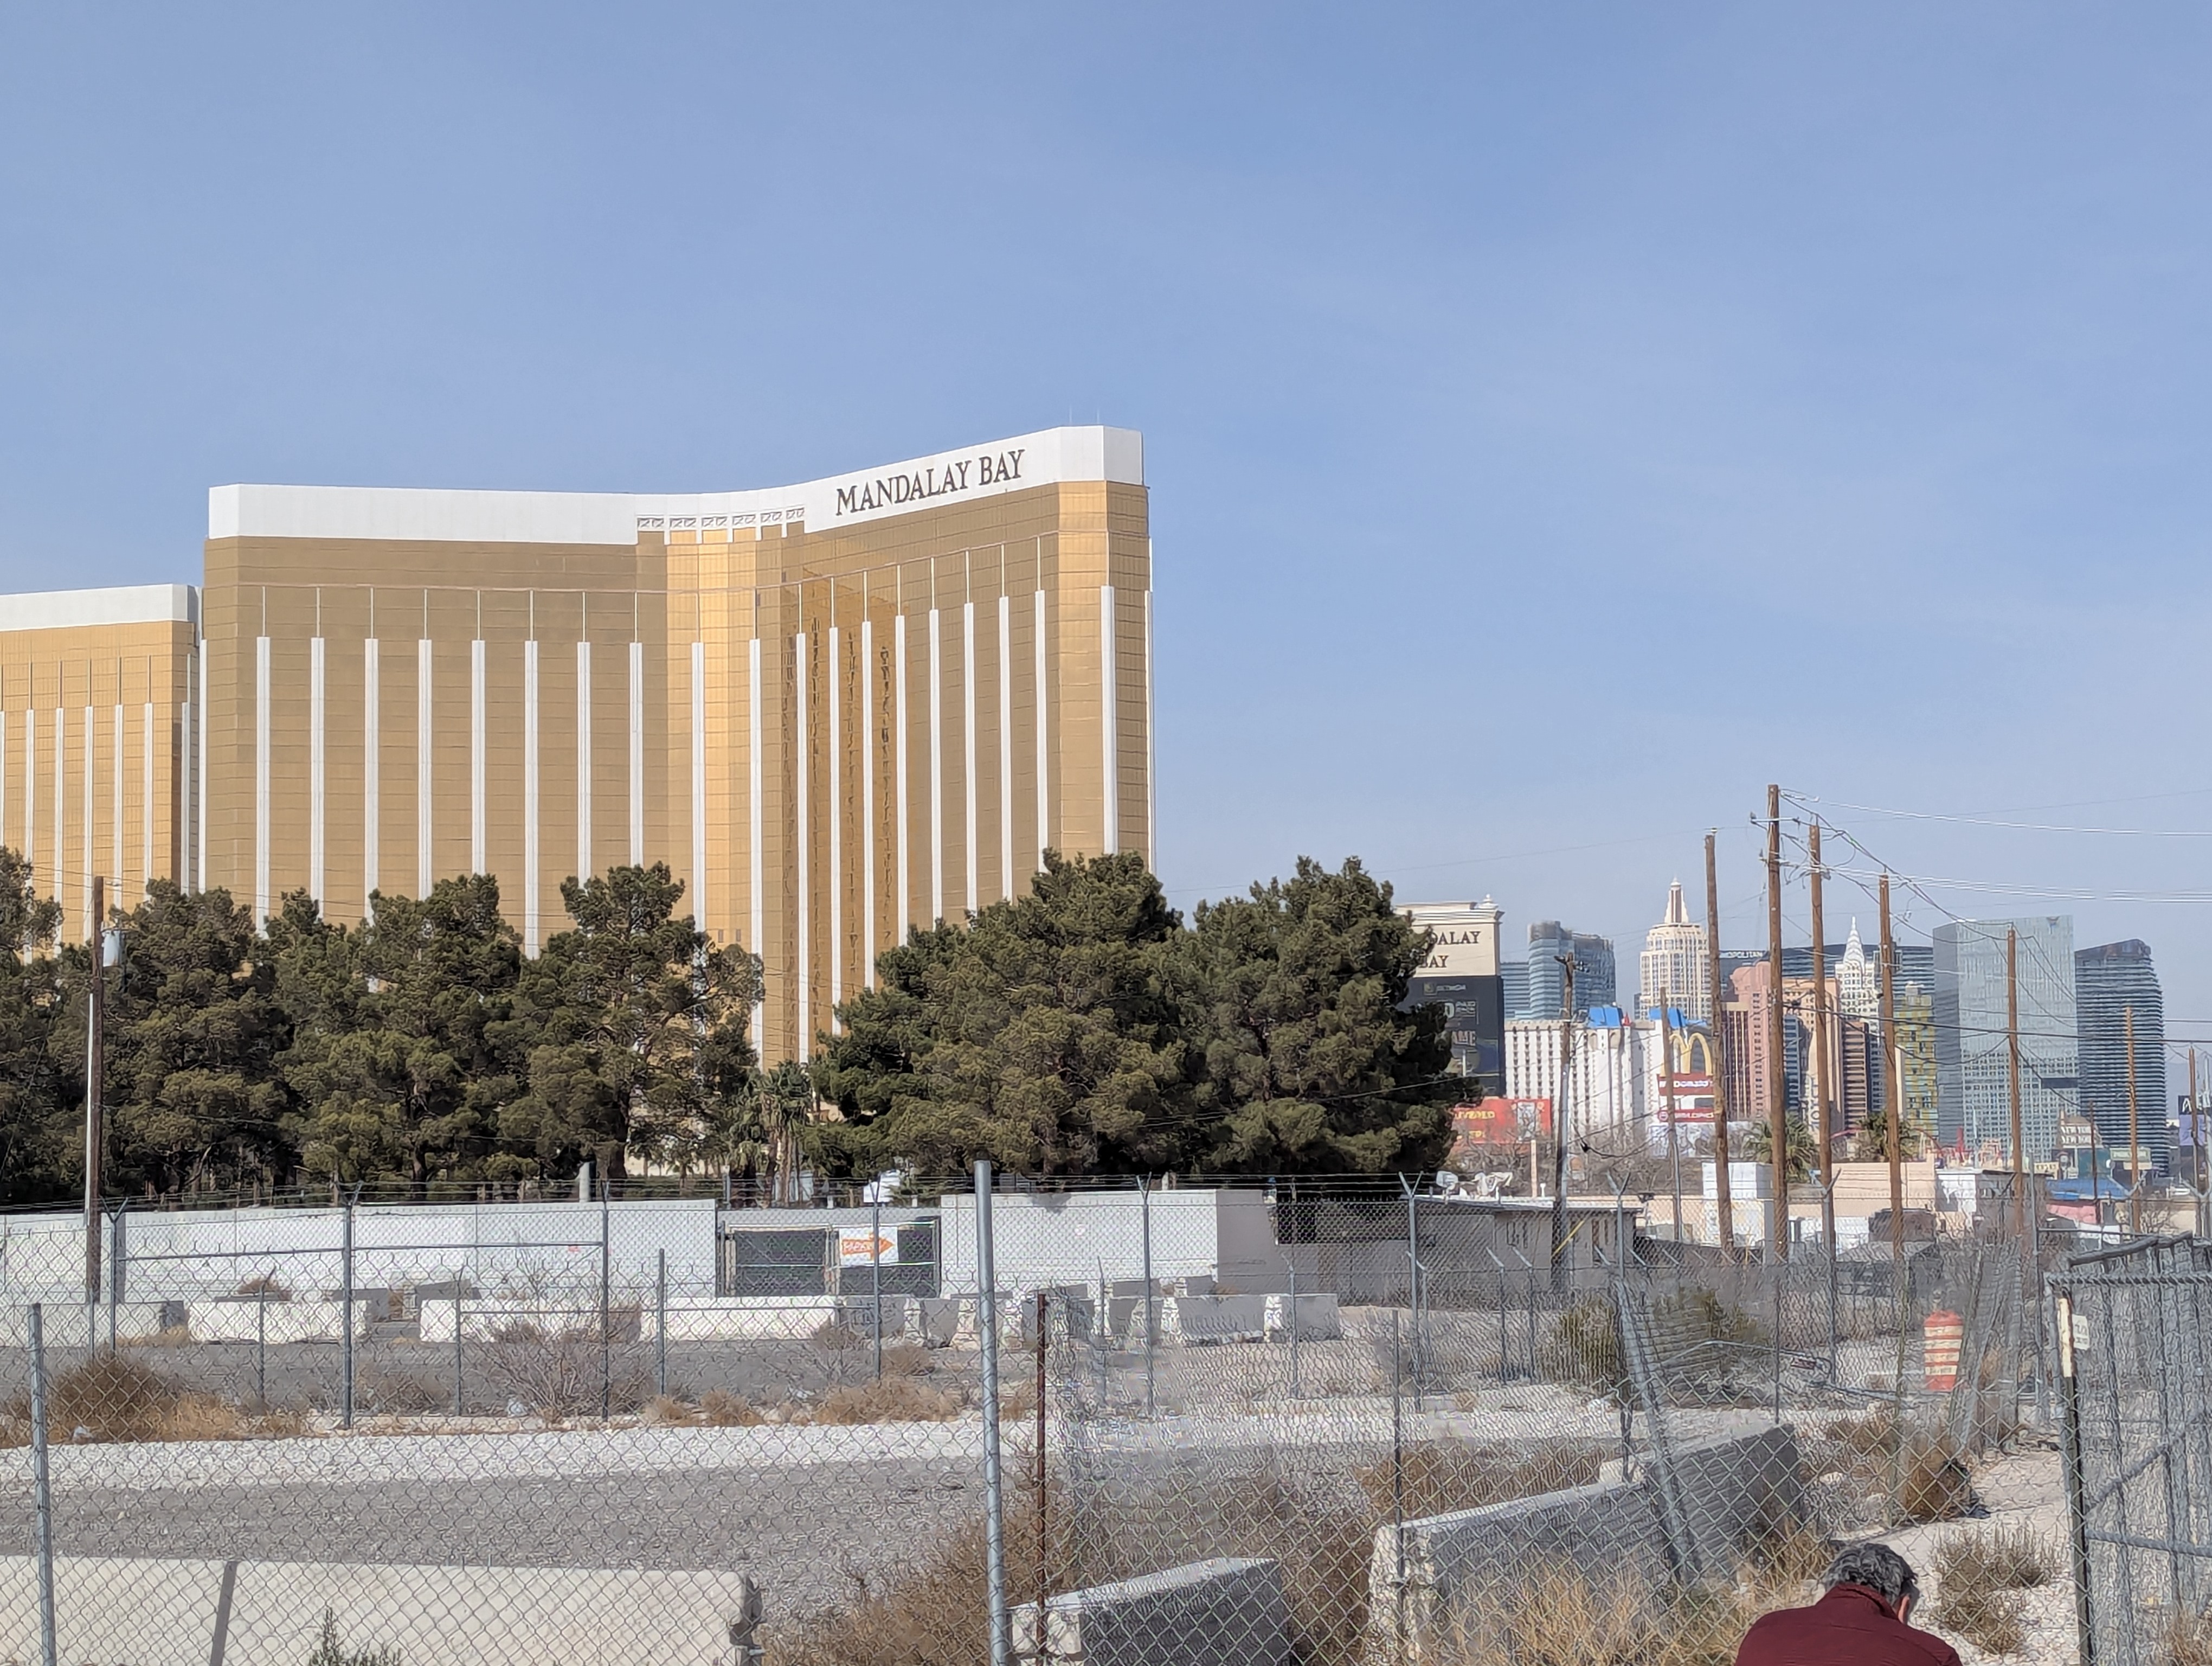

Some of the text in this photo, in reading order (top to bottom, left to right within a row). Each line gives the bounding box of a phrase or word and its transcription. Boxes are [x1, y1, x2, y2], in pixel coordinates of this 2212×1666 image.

[835, 449, 1026, 516] MANDALAY BAY
[1430, 931, 1481, 945] DALAY
